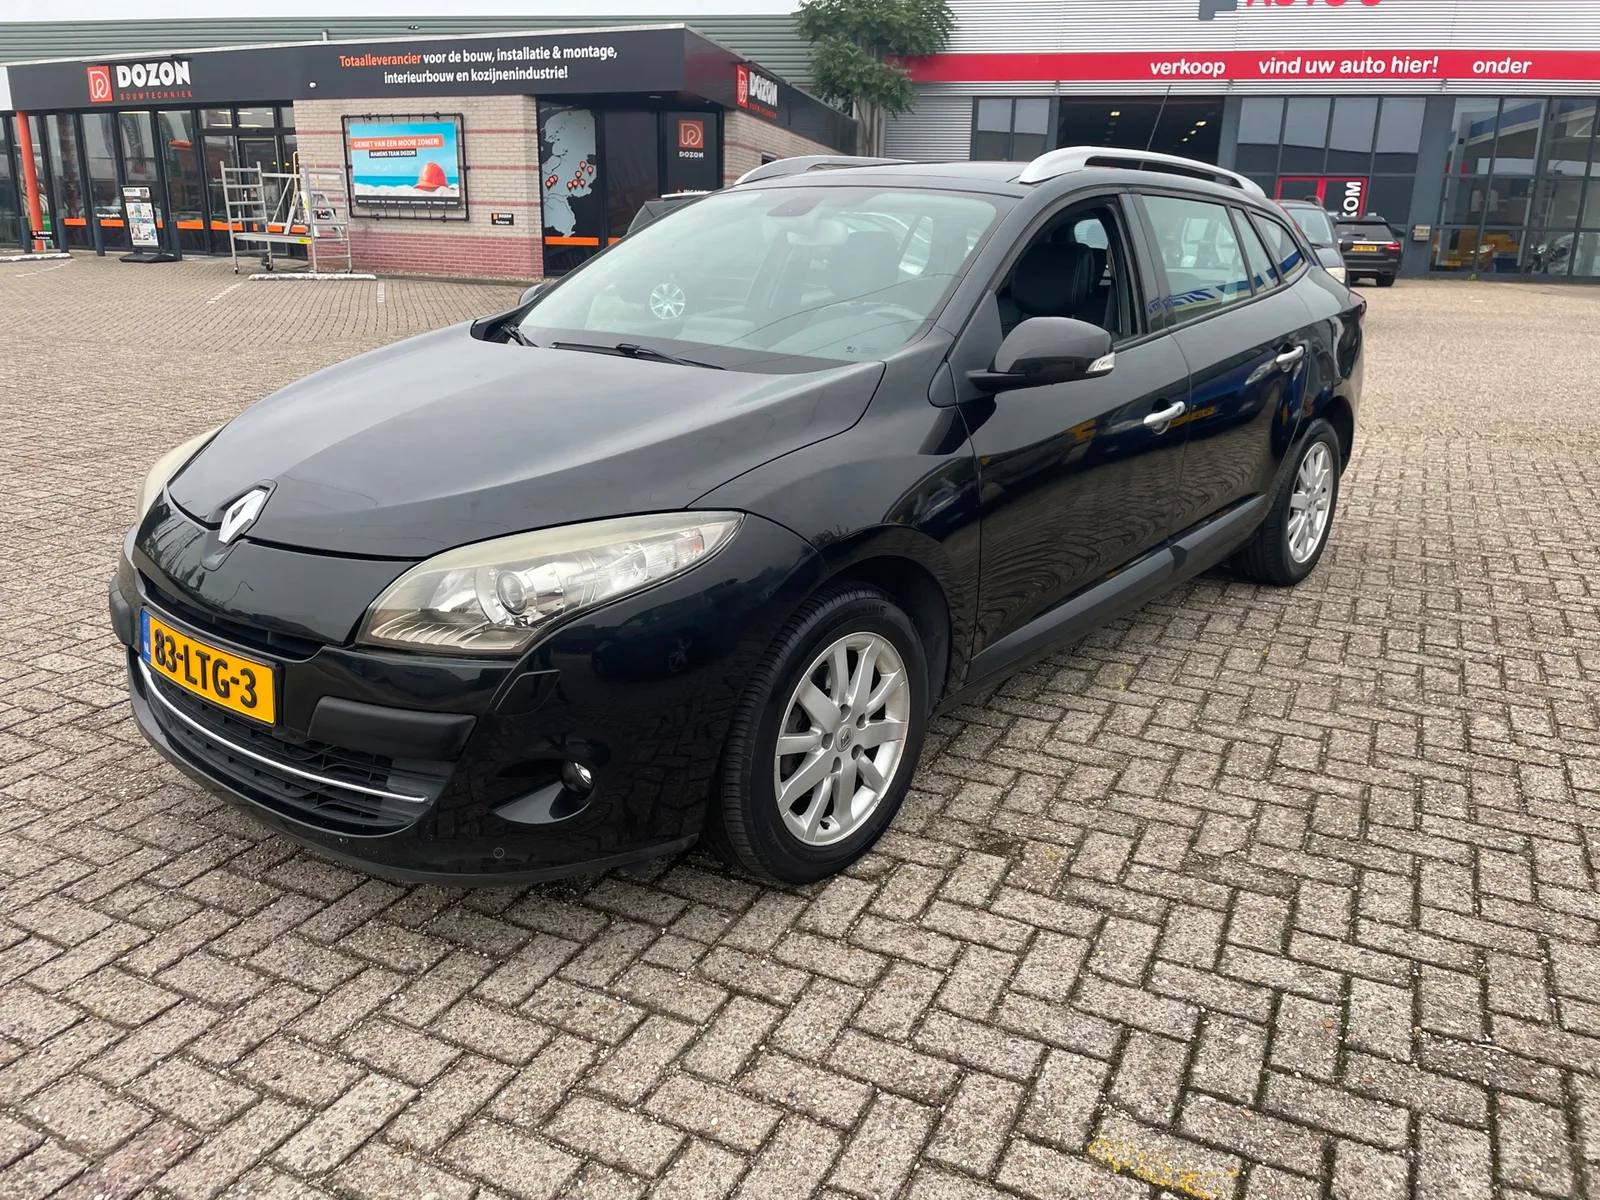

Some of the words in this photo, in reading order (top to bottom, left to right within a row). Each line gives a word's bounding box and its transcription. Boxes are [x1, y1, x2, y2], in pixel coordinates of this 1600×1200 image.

[340, 53, 421, 67] Totaalleverancier
[423, 53, 446, 64] voor
[448, 50, 461, 63] de
[463, 49, 495, 63] bouw,
[497, 46, 550, 61] installatie
[552, 45, 561, 59] &
[563, 45, 618, 60] montage,
[1258, 56, 1301, 74] vind
[1305, 60, 1335, 74] uw
[1339, 56, 1386, 73] auto
[1391, 56, 1439, 73] hier!
[1472, 57, 1532, 74] onder
[116, 61, 191, 88] DOZON
[384, 70, 454, 84] interieurbouw
[456, 70, 469, 82] en
[470, 65, 569, 84] kozijnenindustrie!
[1150, 58, 1226, 78] verkoop
[120, 90, 192, 101] BOUWTECHNIEK
[749, 71, 778, 108] DOZON
[353, 140, 374, 149] GENIET
[373, 140, 386, 148] VAN
[386, 139, 398, 148] EEN
[398, 138, 417, 147] MOOIE
[418, 137, 440, 146] ZOMER!
[143, 641, 151, 655] NL
[154, 628, 258, 709] 83-LTG-3
